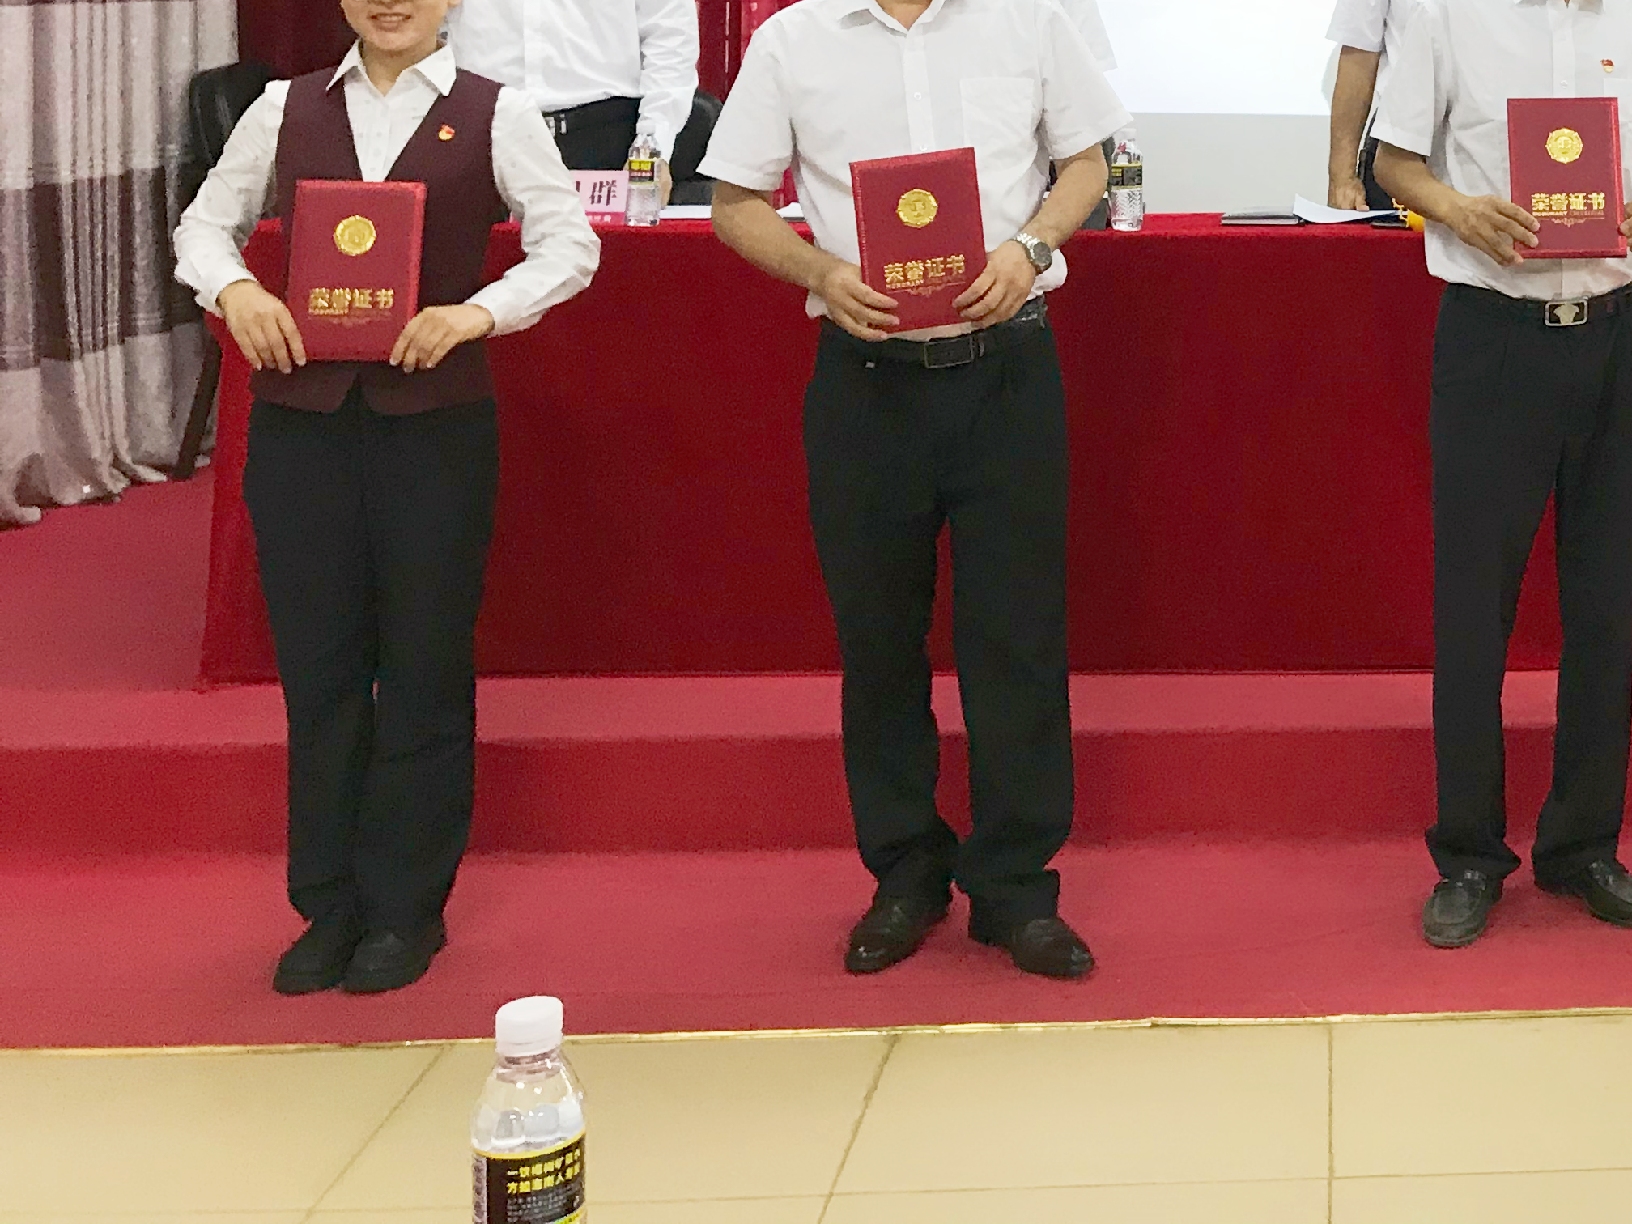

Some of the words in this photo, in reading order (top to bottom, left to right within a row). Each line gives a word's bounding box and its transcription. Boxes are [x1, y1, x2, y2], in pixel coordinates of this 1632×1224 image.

[1531, 192, 1605, 211] 荣誉证书
[883, 254, 965, 283] 荣誉证书
